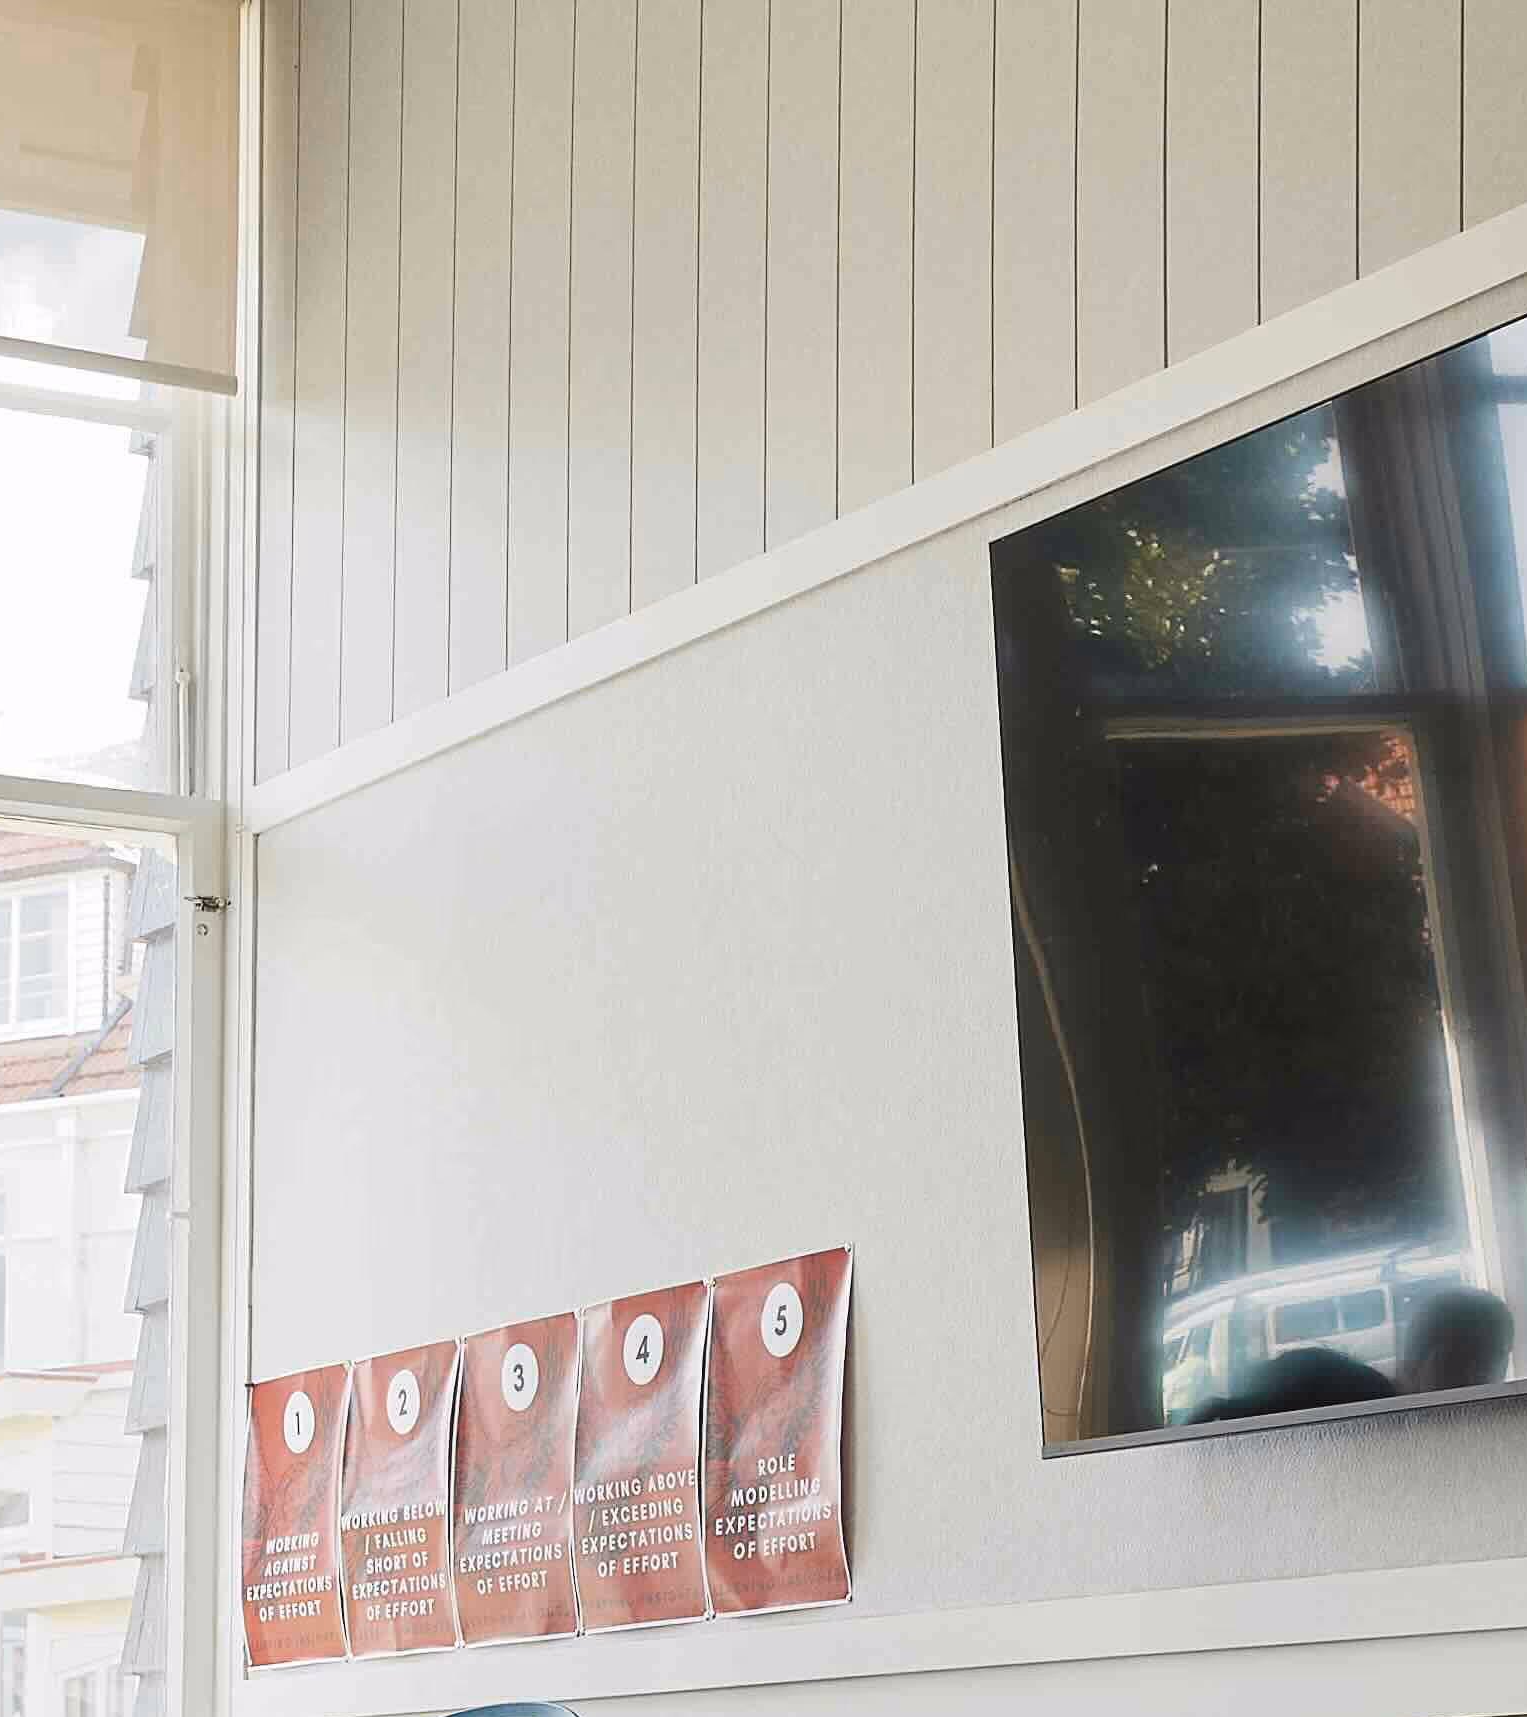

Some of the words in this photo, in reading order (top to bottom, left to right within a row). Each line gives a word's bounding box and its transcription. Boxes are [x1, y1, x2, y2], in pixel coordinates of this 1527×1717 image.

[775, 1305, 788, 1336] 5
[635, 1335, 650, 1365] 4
[513, 1364, 526, 1393] 3
[398, 1391, 409, 1415] 2
[294, 1411, 302, 1436] 1
[758, 1453, 796, 1476] ROLE
[573, 1478, 642, 1505] WORKING
[648, 1469, 695, 1493] ABOVE
[730, 1477, 821, 1507] MODELLING
[341, 1508, 398, 1532] WORKING
[403, 1499, 446, 1521] BELOW
[464, 1499, 529, 1524] WORKING
[534, 1496, 553, 1513] AT
[557, 1491, 567, 1513] /
[588, 1510, 596, 1533] /
[601, 1498, 684, 1527] EXCEEDING
[715, 1503, 832, 1536] EXPECTATIONS
[265, 1531, 319, 1555] WORKING
[374, 1527, 427, 1549] FALLING
[481, 1522, 542, 1546] MEETING
[581, 1523, 694, 1555] EXPECTATIONS
[733, 1541, 757, 1560] OF
[763, 1532, 816, 1556] EFFORT
[264, 1554, 317, 1577] AGAINST
[366, 1554, 407, 1575] SHORT
[412, 1551, 429, 1568] OF
[459, 1543, 563, 1574] EXPECTATIONS
[598, 1561, 617, 1579] OF
[623, 1551, 679, 1576] EFFORT
[246, 1575, 333, 1602] EXPECTATIONS
[352, 1573, 446, 1600] EXPECTATIONS
[477, 1578, 494, 1595] OF
[499, 1570, 548, 1593] EFFORT
[259, 1606, 275, 1623] OF
[279, 1600, 322, 1619] EFFORT
[366, 1604, 381, 1621] OF
[385, 1599, 435, 1619] EFFORT
